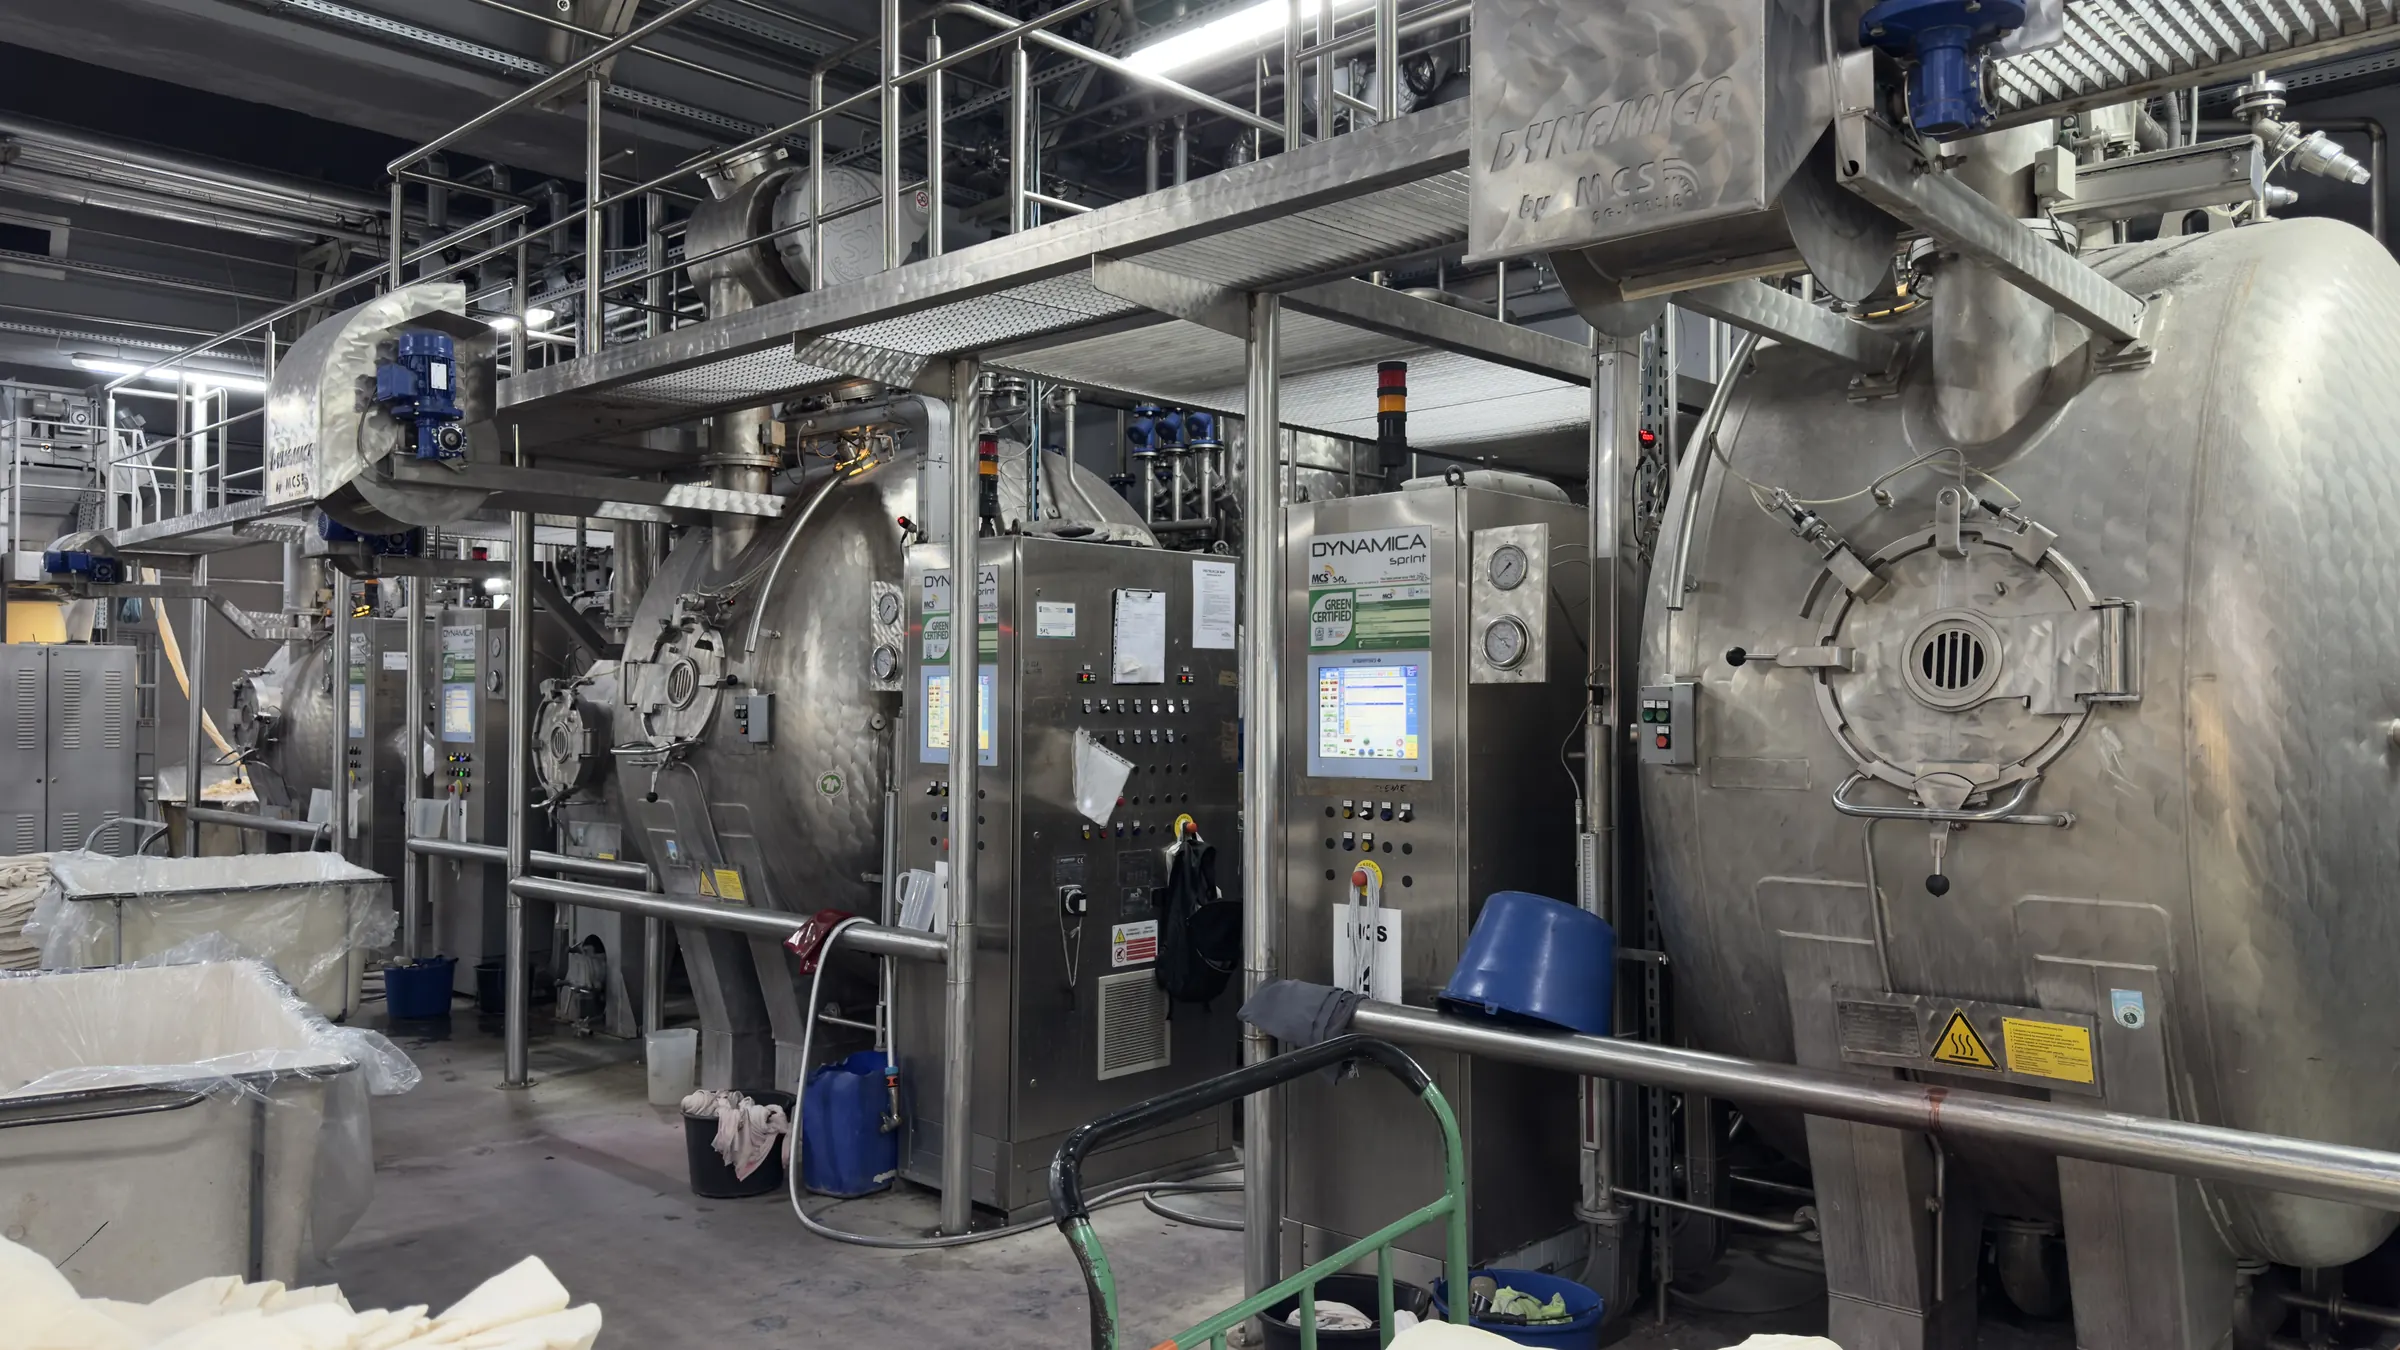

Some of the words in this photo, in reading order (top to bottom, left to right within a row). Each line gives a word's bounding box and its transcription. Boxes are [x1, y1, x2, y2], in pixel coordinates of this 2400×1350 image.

[1490, 76, 1733, 173] DYNAMICA
[1519, 194, 1551, 222] by
[1575, 162, 1655, 207] MCS
[1312, 533, 1427, 558] DYNAMICA
[1389, 554, 1427, 566] sprint
[1312, 573, 1329, 584] MCS
[924, 600, 935, 609] MCS
[1325, 598, 1352, 611] GREEN
[1312, 610, 1352, 623] CERTIFIED
[932, 621, 949, 631] GREEN
[924, 631, 949, 640] CERTIFIED
